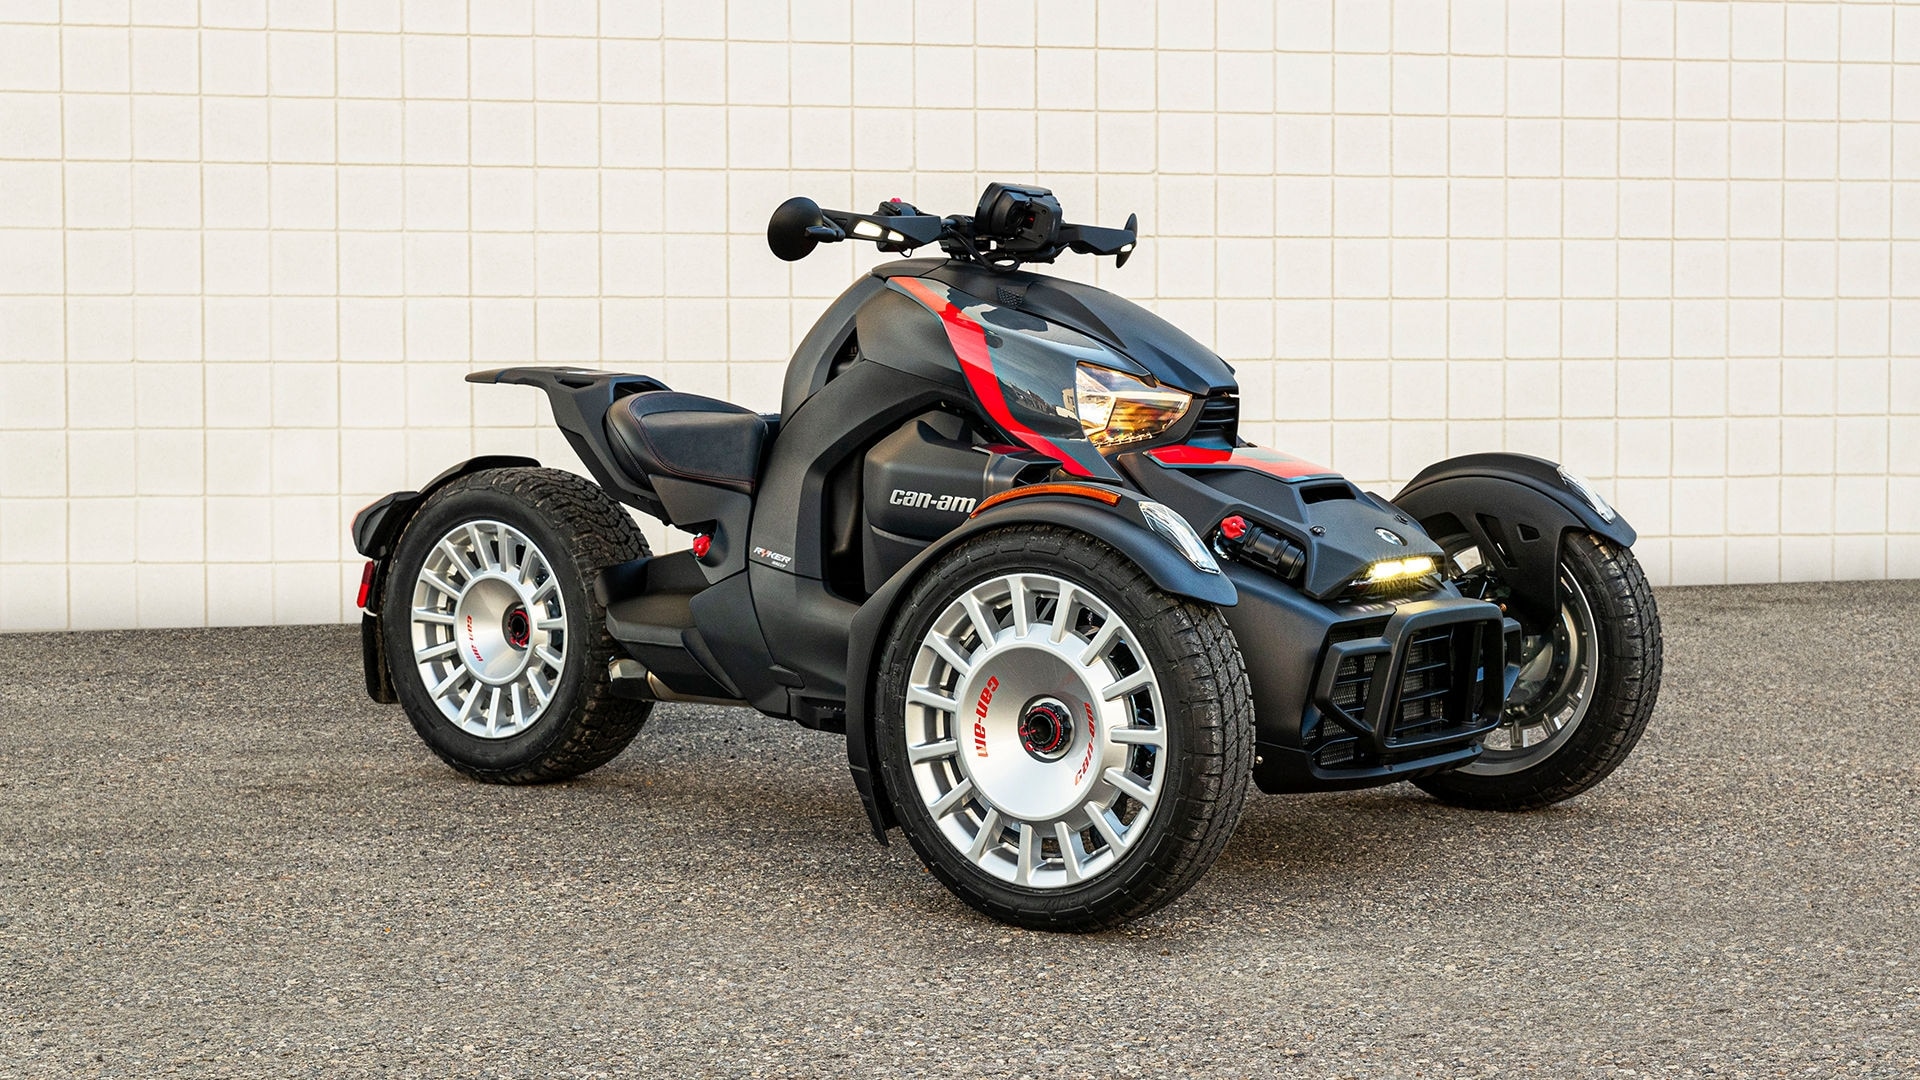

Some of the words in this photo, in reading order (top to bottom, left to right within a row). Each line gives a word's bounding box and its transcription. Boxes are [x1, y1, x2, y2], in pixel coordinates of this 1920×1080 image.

[889, 489, 976, 514] can-am
[753, 546, 792, 564] RYKER
[973, 675, 1000, 758] can-am
